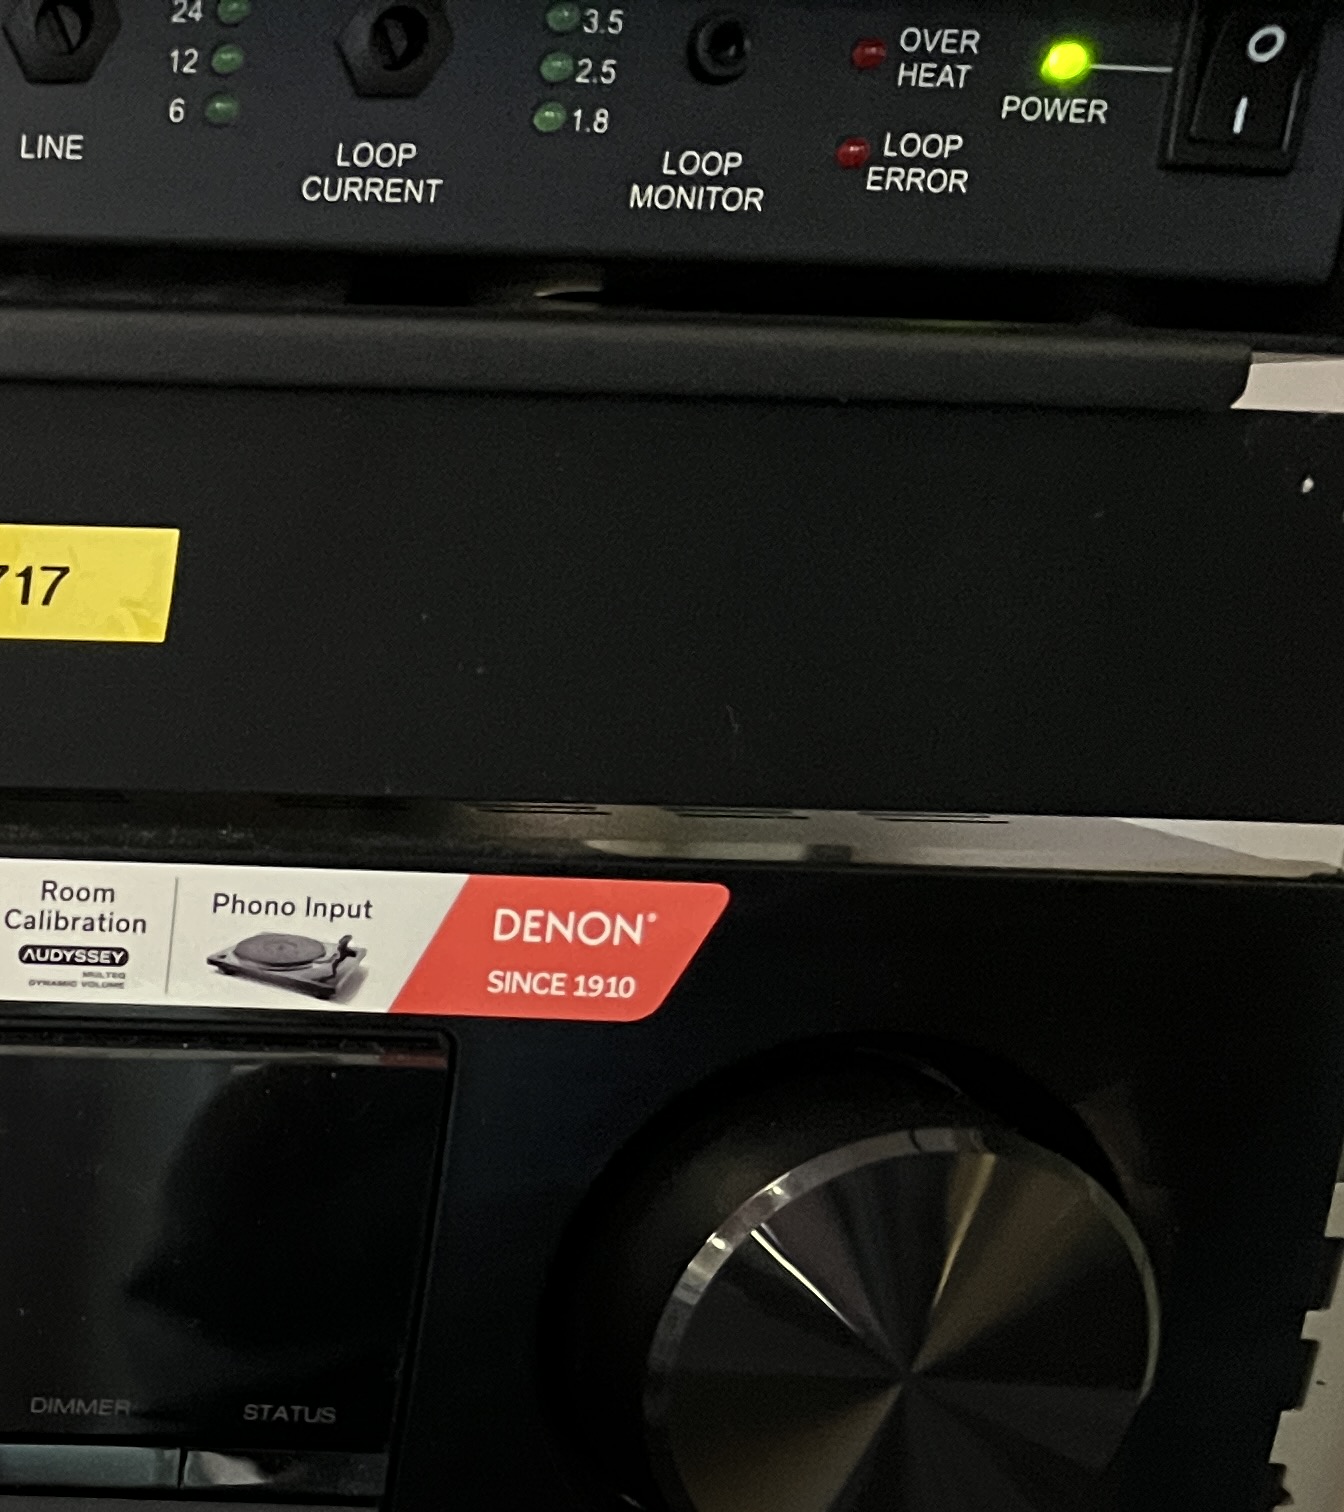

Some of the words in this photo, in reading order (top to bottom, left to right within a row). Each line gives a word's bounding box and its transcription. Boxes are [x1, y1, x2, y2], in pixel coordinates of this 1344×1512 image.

[583, 8, 623, 35] 3.5
[900, 29, 980, 55] OVER
[170, 49, 199, 73] 12
[576, 59, 616, 84] 2.5
[897, 65, 972, 90] HEAT
[572, 108, 610, 133] 1.8
[1002, 96, 1108, 124] POWER
[21, 134, 84, 161] LINE
[336, 143, 417, 169] LOOP
[883, 133, 962, 159] LOOP
[662, 151, 742, 177] LOOP
[301, 177, 442, 204] CURRENT
[866, 166, 968, 194] ERROR
[630, 185, 764, 212] MONITOR
[41, 880, 115, 902] Room
[212, 892, 297, 918] Phono
[304, 896, 373, 922] Input
[4, 909, 148, 935] Calibration
[493, 908, 644, 945] DENON
[22, 948, 124, 963] AUDYSSEY
[486, 969, 566, 997] SINCE
[573, 973, 635, 999] 1910
[29, 1397, 132, 1418] DIMMER
[242, 1404, 336, 1425] STATUS
